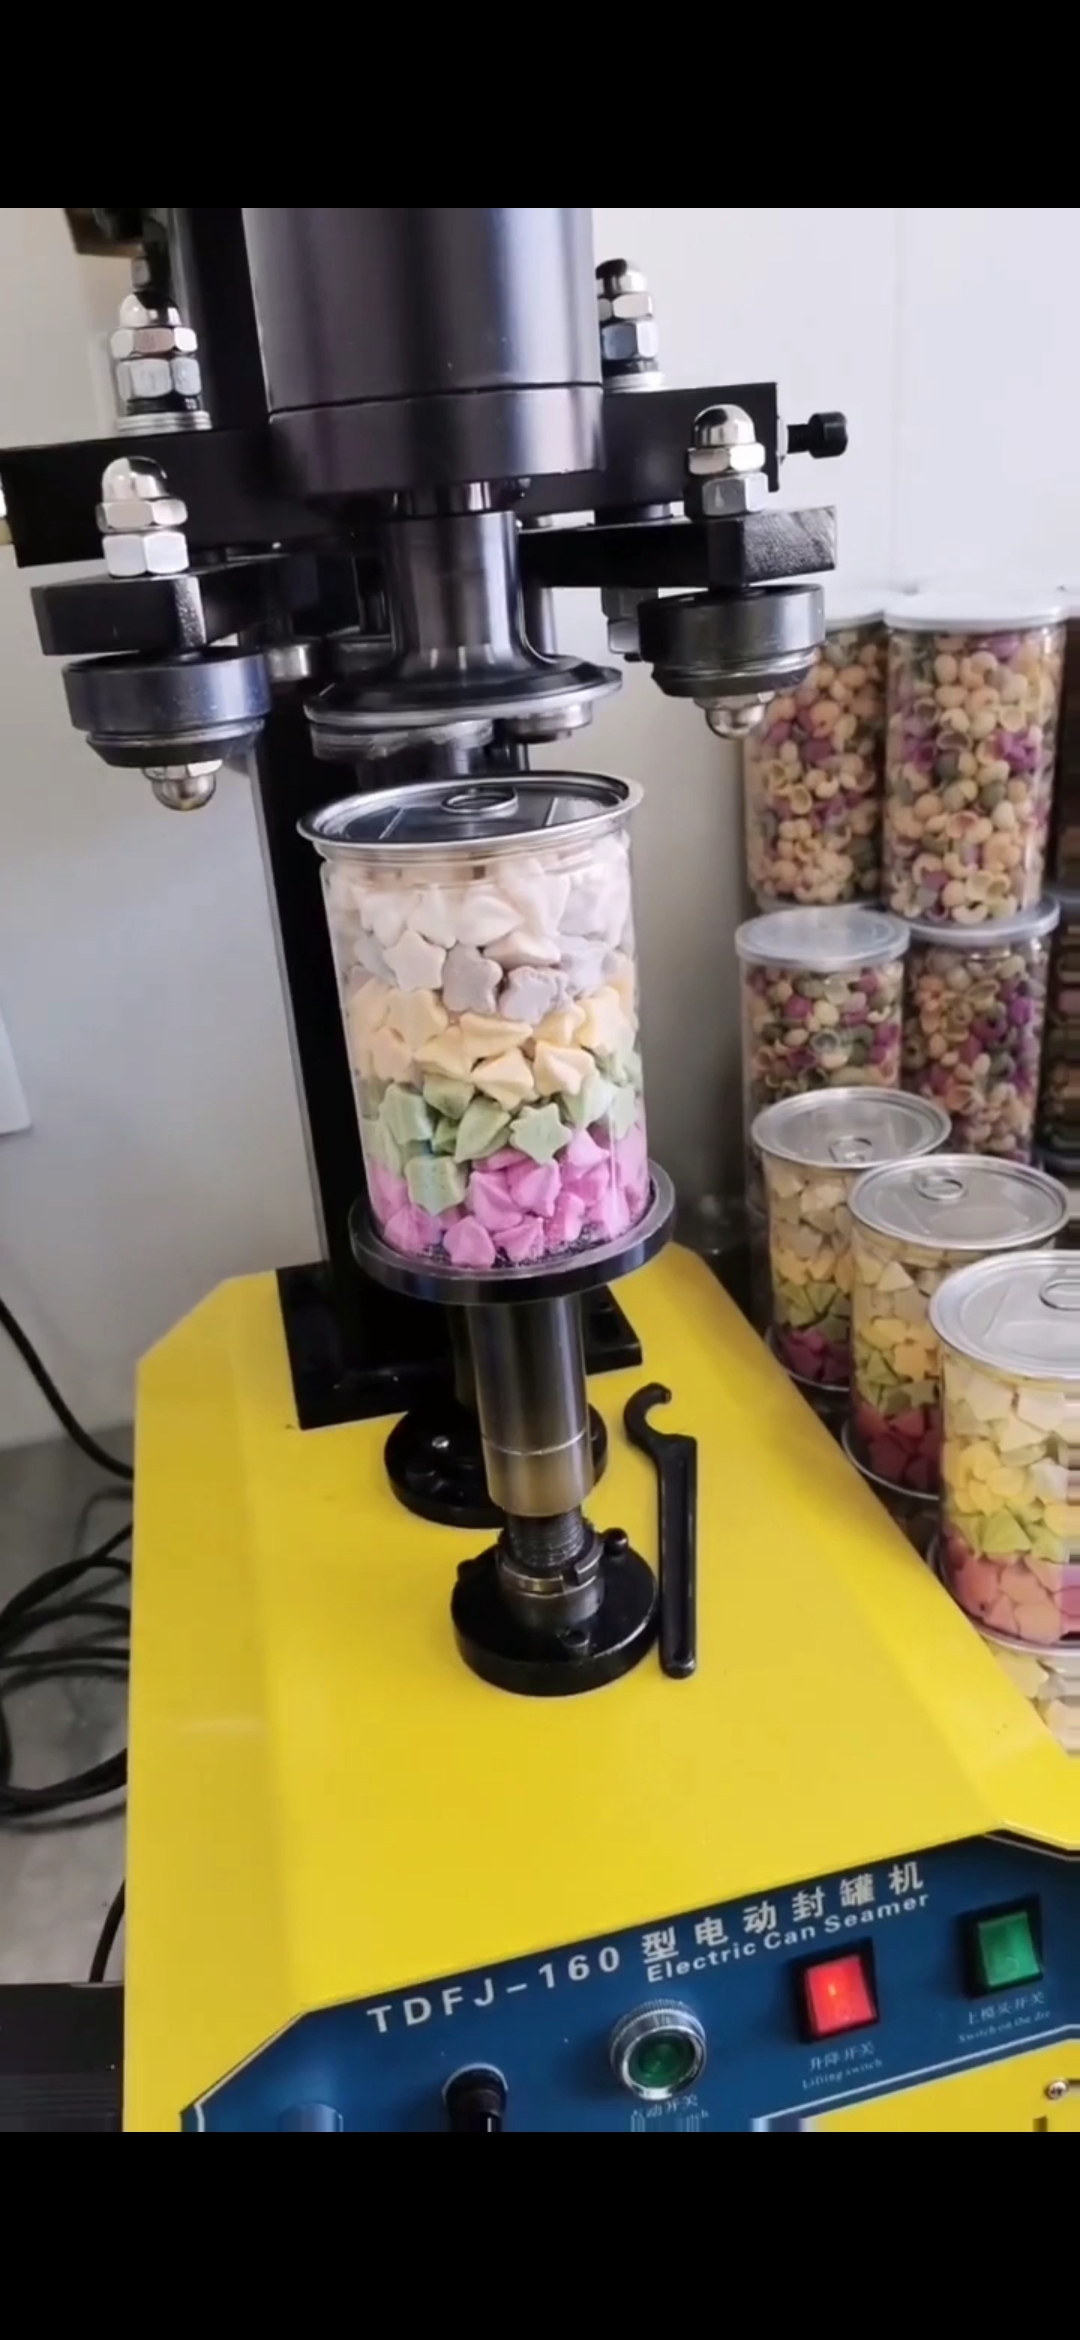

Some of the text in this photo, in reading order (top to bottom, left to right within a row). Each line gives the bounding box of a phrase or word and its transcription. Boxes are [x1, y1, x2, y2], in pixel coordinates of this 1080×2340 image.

[366, 1860, 924, 2034] TDFJ-160 型电动封罐机
[647, 1892, 929, 1983] Electric Can Seamer
